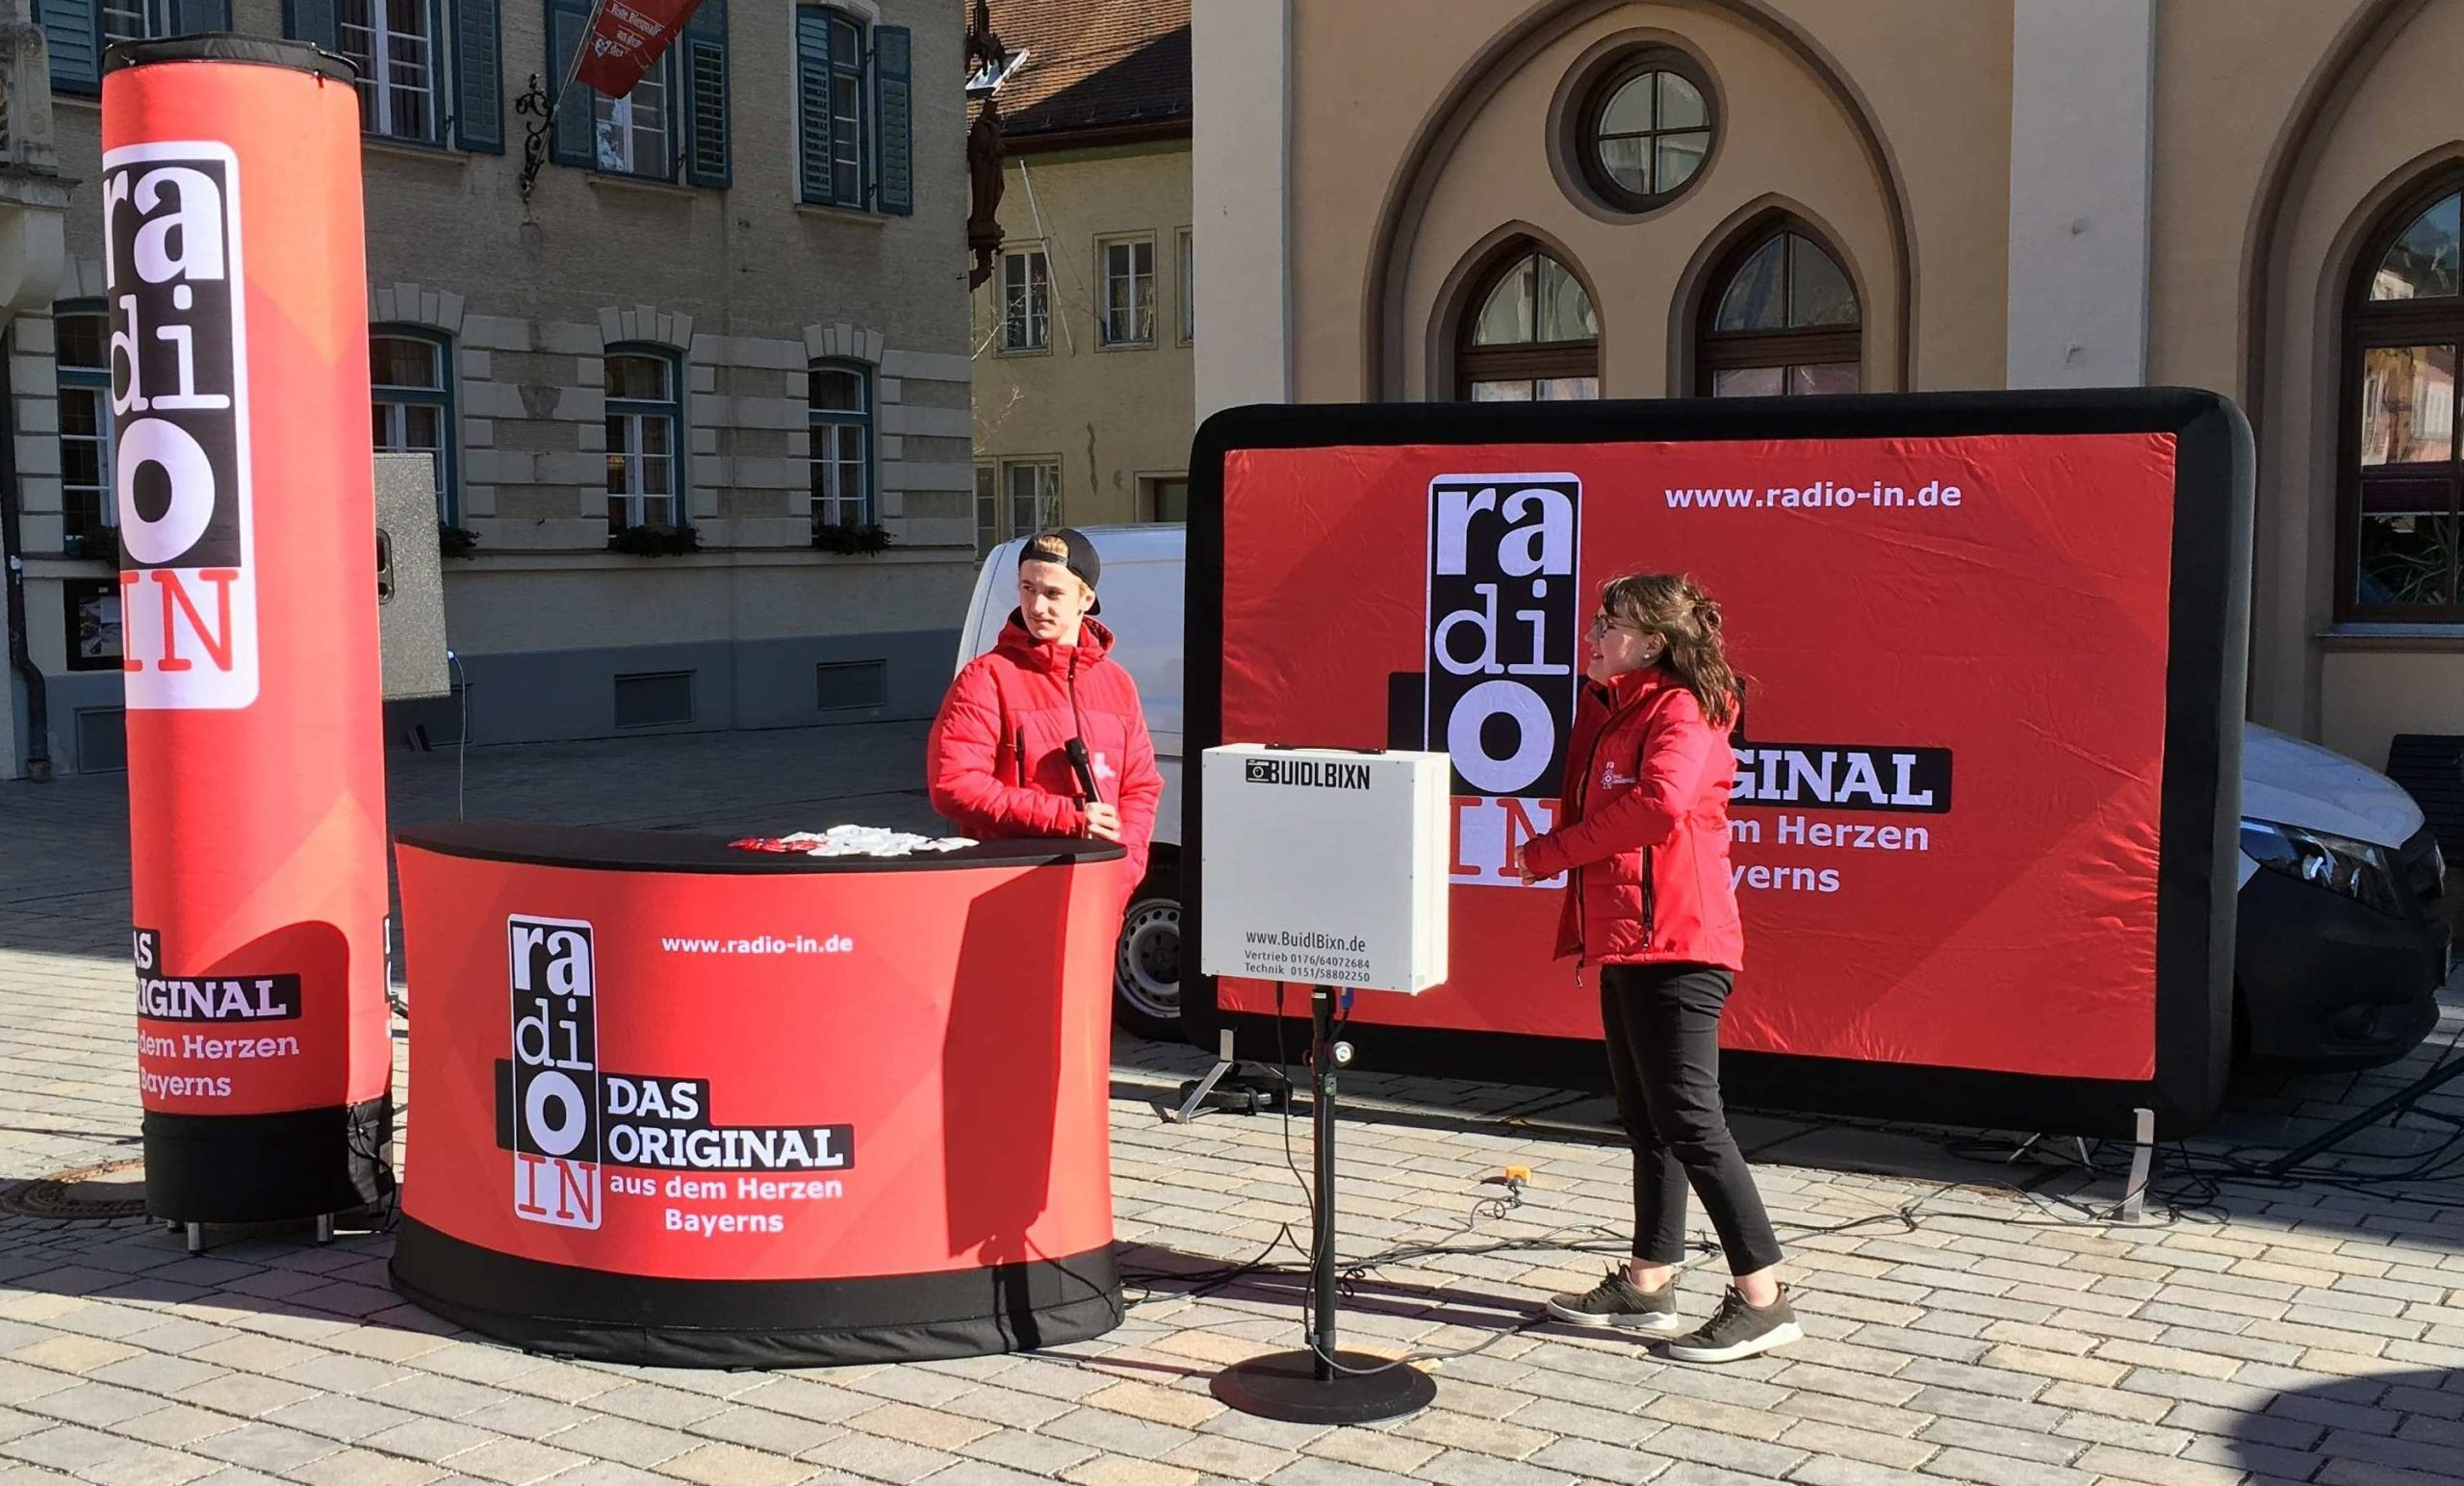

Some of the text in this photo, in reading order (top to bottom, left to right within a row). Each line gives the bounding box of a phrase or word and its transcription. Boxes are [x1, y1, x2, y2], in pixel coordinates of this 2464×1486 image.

[1664, 481, 1961, 507] www.radio-in.de
[1270, 760, 1371, 790] BUIDLBIXN
[1731, 748, 1933, 806] GINAL
[1778, 816, 1929, 851] Herzen
[662, 935, 853, 954] www.radio-in.de
[1245, 931, 1366, 952] www.BuidlBixn.de
[1245, 950, 1370, 969] Vertrieb 0176/64072684
[1245, 962, 1371, 982] Technik 0151/58802250
[140, 1030, 300, 1060] dem Herzen
[141, 1065, 232, 1100] Bayerns
[607, 1078, 699, 1119] DAS
[608, 1124, 844, 1168] ORIGINAL
[517, 1153, 598, 1224] IN
[610, 1175, 843, 1200] aus dem Herzen
[664, 1209, 784, 1239] Bayerns
